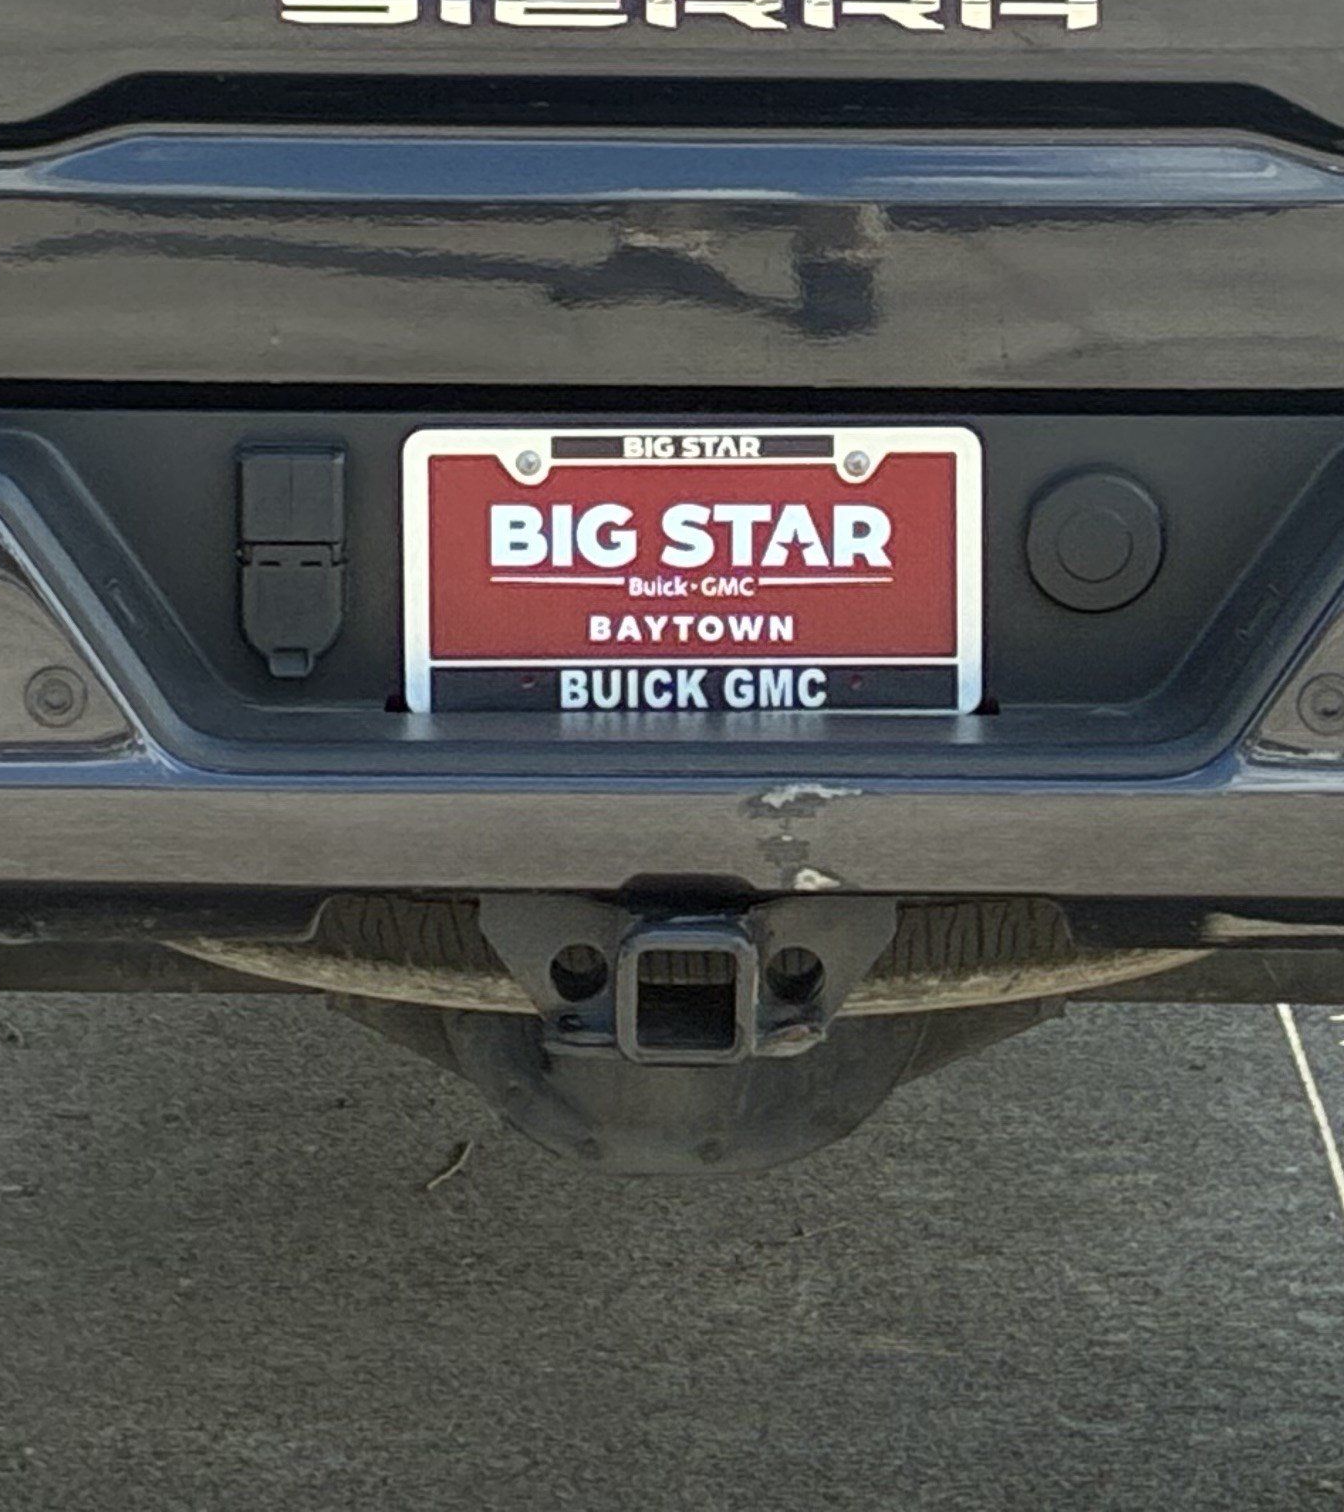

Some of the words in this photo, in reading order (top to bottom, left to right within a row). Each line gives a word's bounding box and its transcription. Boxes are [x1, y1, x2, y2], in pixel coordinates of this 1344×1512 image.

[622, 434, 674, 458] BIG
[681, 434, 762, 458] STAR
[489, 502, 638, 568] BIG
[660, 502, 893, 568] STAR
[588, 614, 795, 642] BAYTOWN
[559, 668, 708, 709] BUICK
[723, 668, 828, 709] GMC
